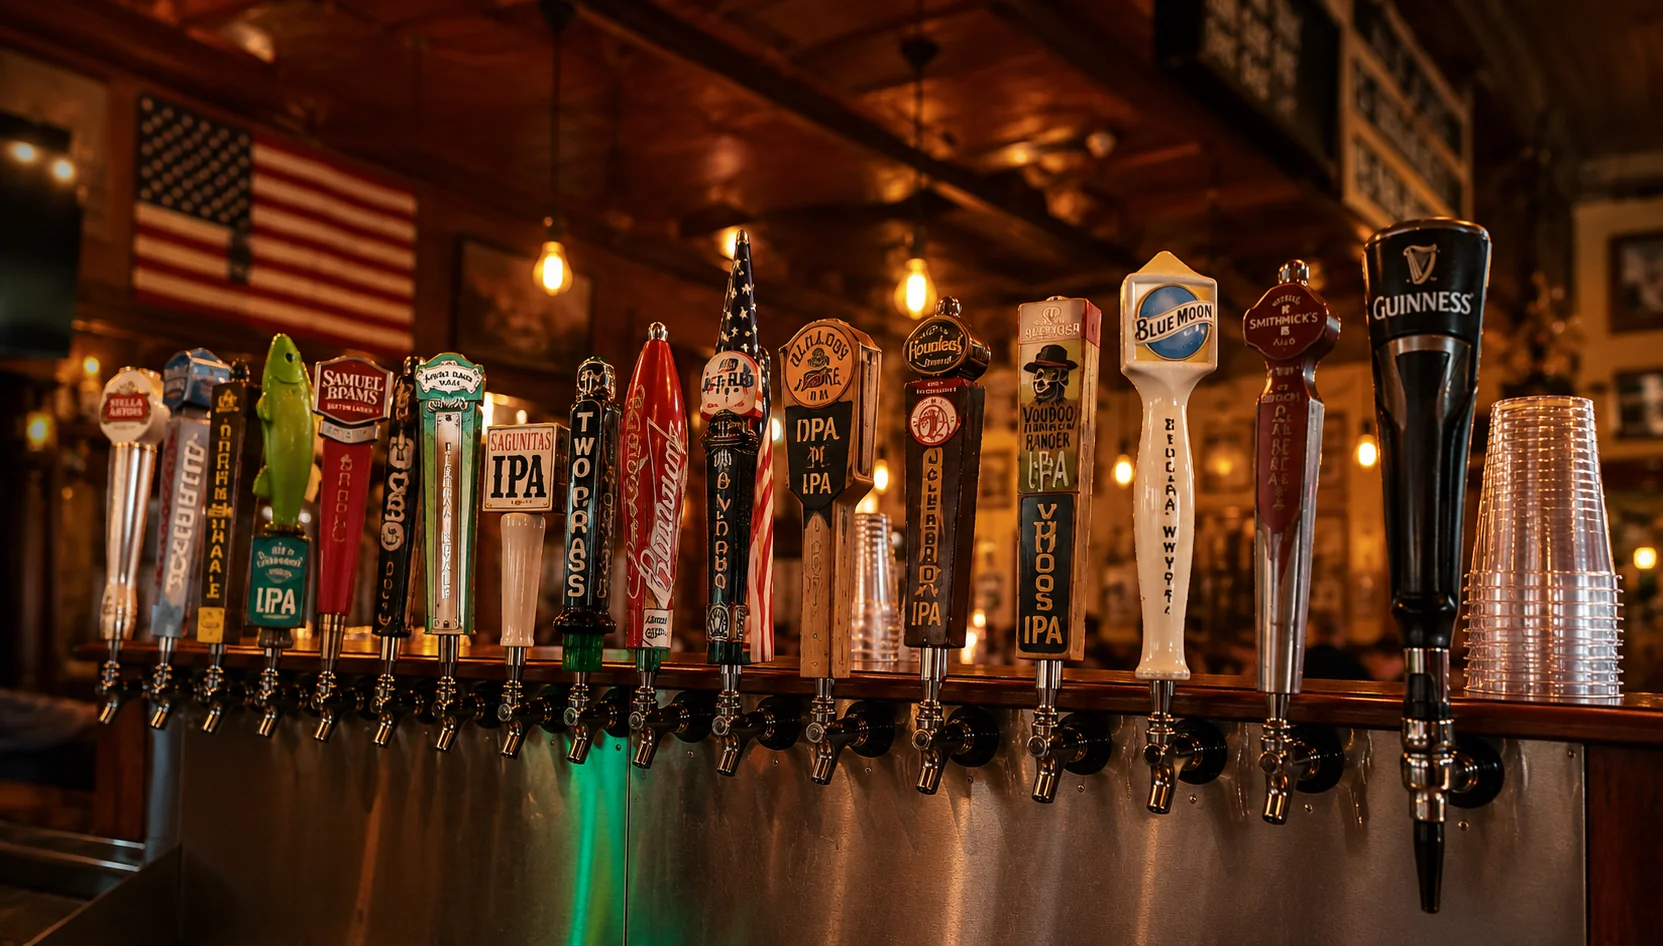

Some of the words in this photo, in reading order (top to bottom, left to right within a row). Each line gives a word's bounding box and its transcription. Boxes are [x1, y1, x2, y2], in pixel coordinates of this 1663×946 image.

[1373, 291, 1472, 320] GUINNESS
[1135, 318, 1174, 341] BLUE
[1177, 304, 1213, 327] MOON
[323, 370, 384, 392] SAMUEL
[490, 454, 547, 498] IPA
[1024, 615, 1063, 644] IPA
